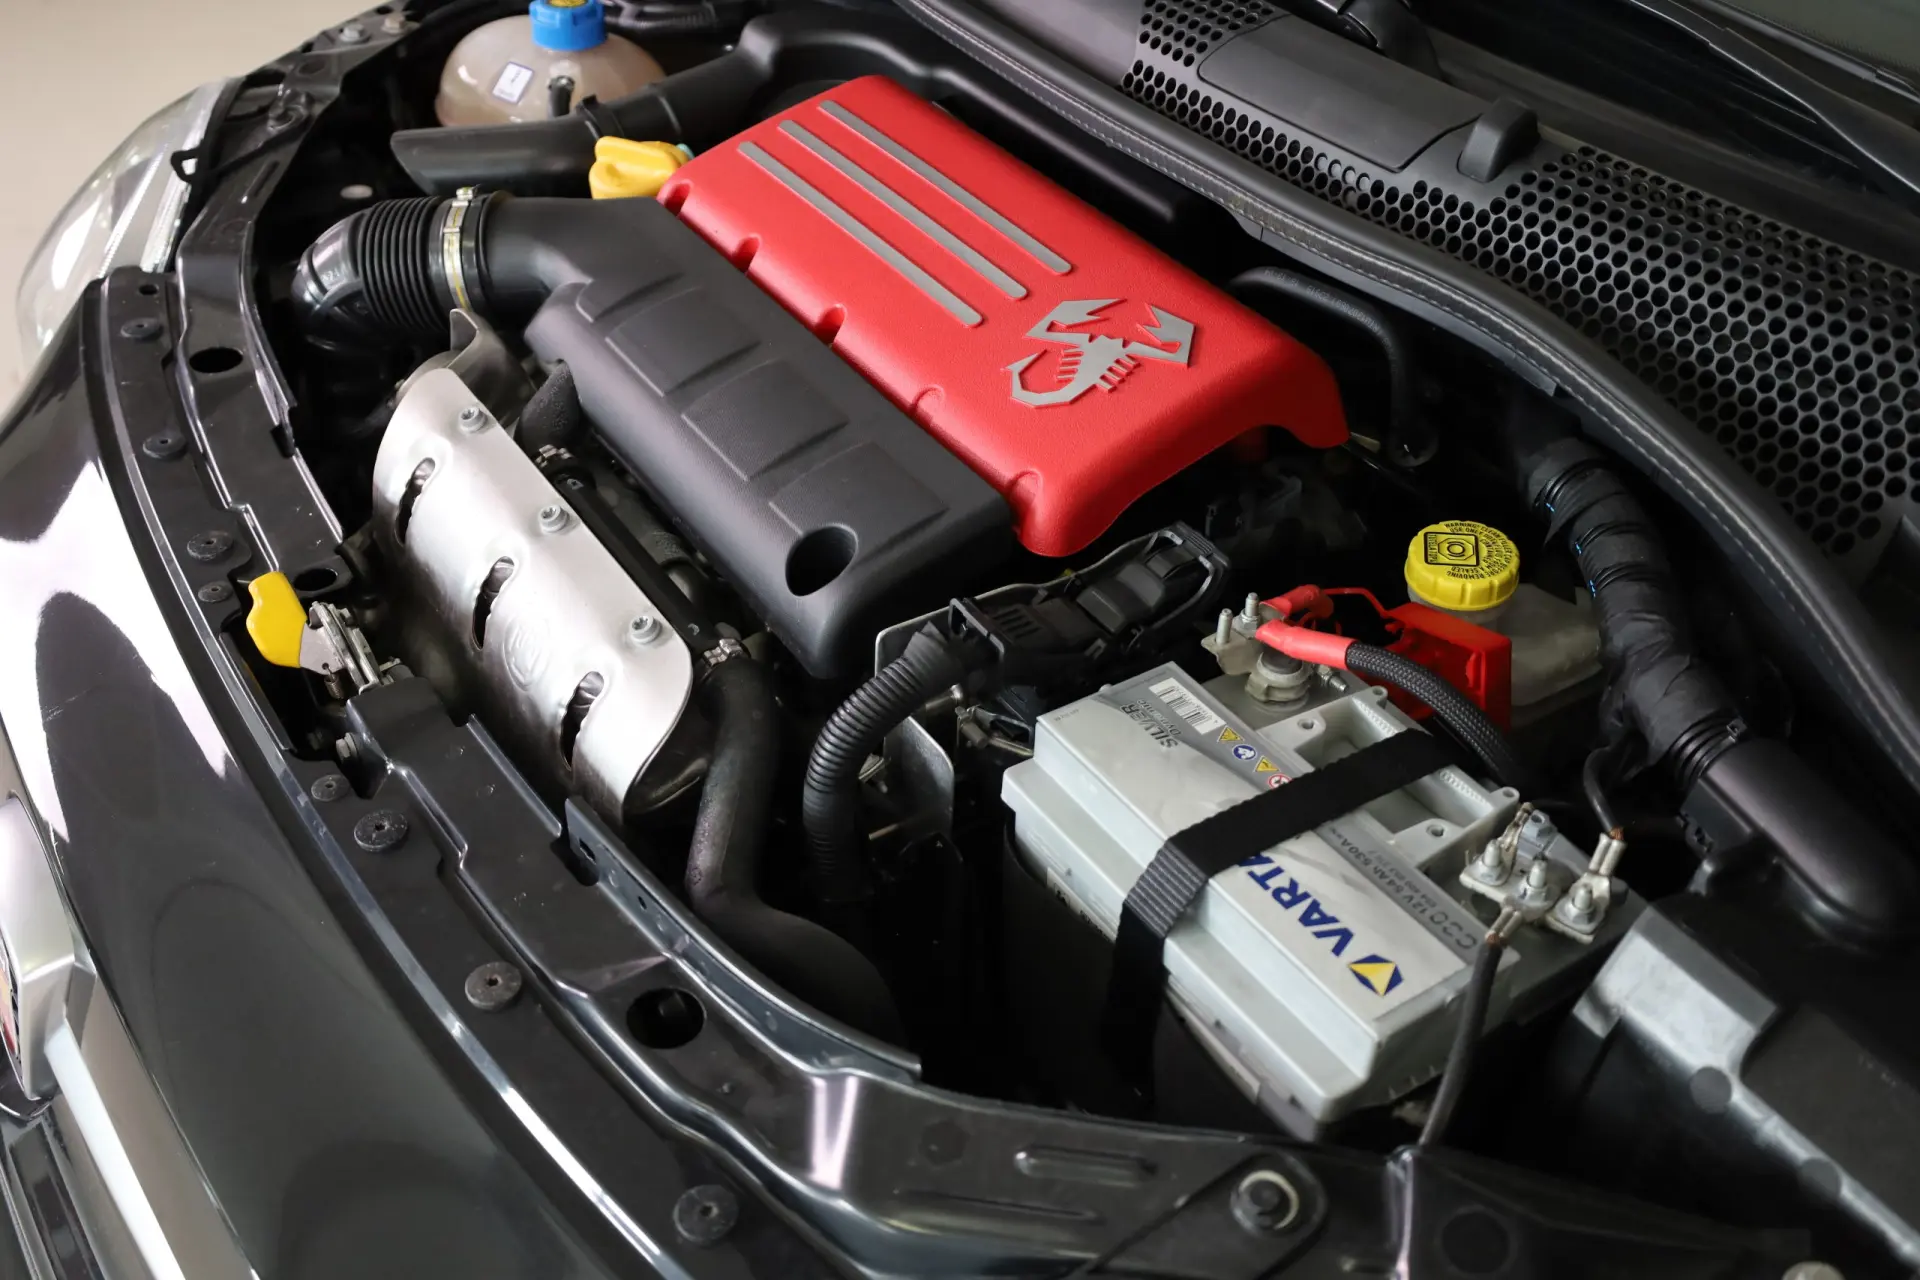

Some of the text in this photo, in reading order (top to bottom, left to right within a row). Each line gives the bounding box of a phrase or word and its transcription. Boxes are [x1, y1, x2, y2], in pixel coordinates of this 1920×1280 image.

[1446, 570, 1485, 579] REMOVING
[1121, 704, 1178, 748] SILVER
[1373, 865, 1404, 893] 54Ah
[1403, 893, 1428, 914] 12V
